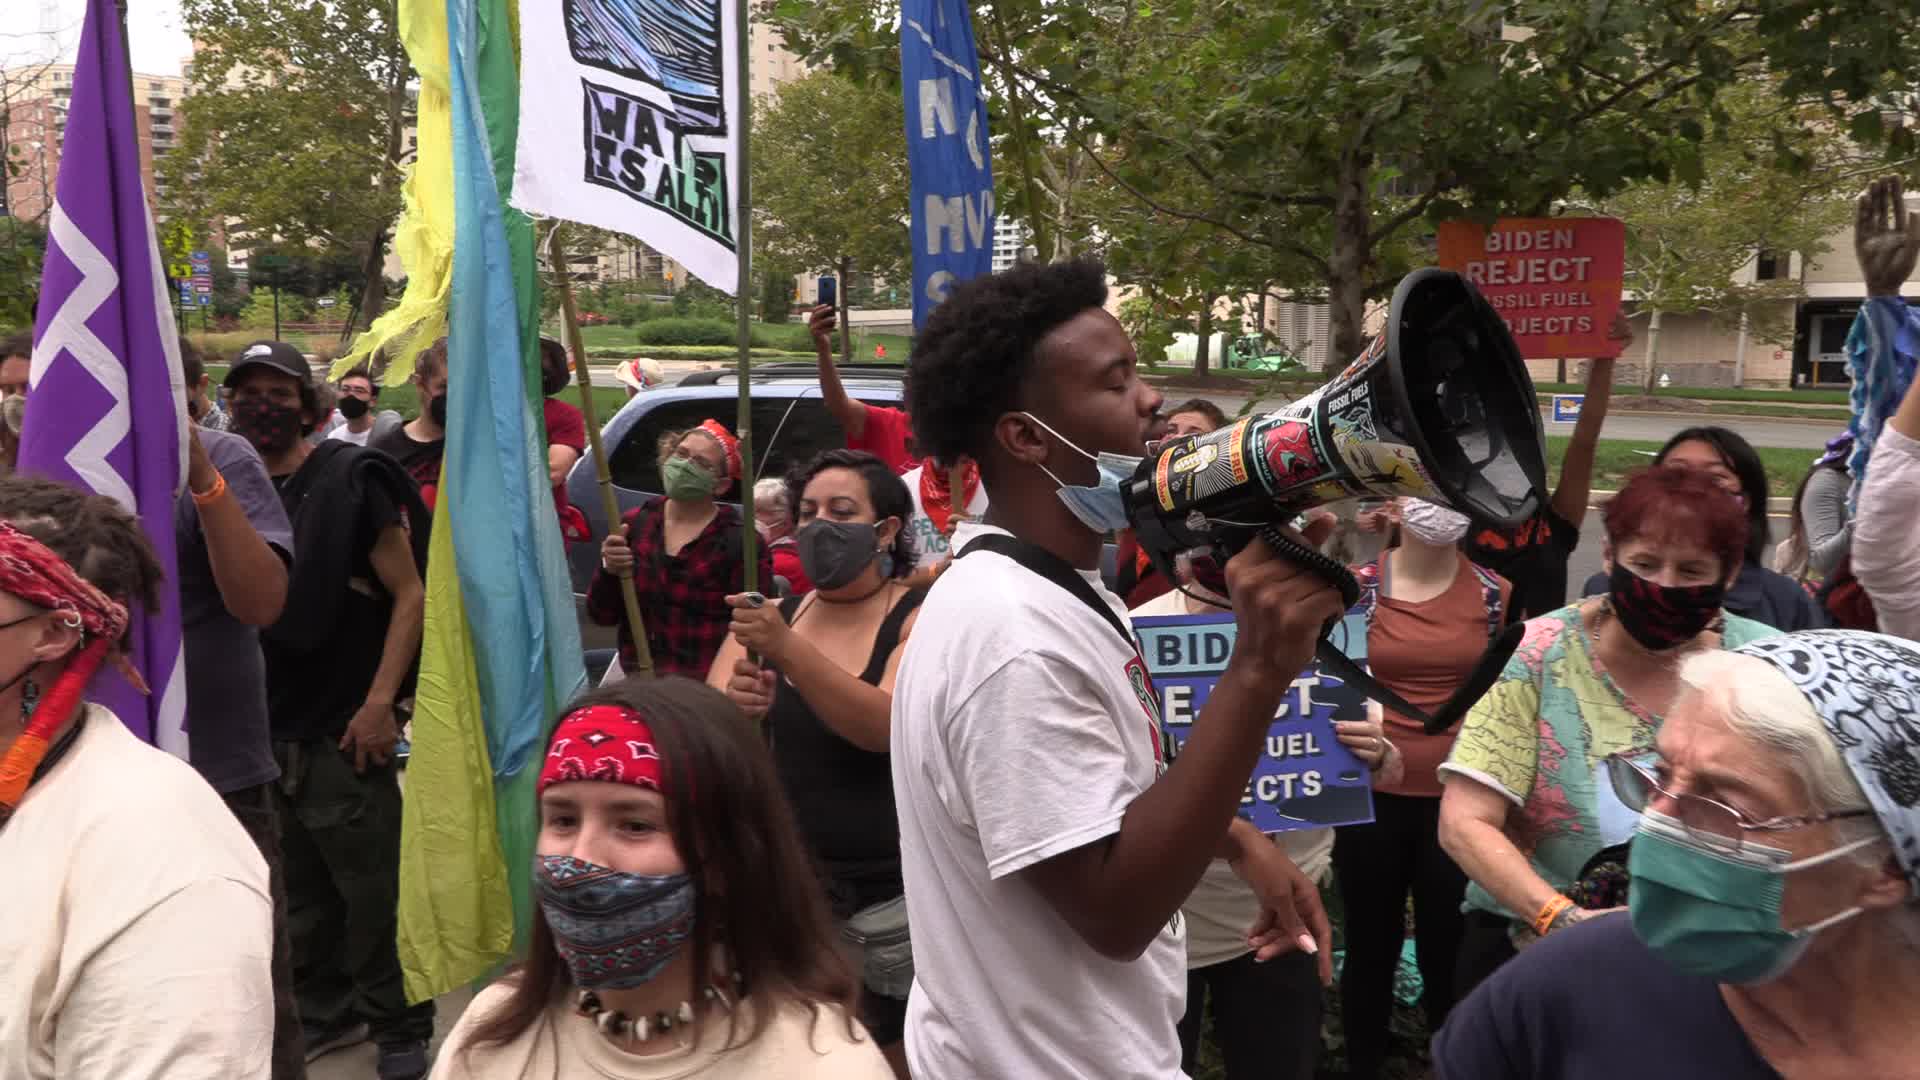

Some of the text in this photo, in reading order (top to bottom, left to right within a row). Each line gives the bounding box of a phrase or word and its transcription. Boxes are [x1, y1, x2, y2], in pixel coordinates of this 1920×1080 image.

[593, 136, 648, 193] IS
[1485, 229, 1574, 252] BIDEN
[1465, 257, 1592, 284] REJECT
[1486, 292, 1592, 308] SSIL FUEL
[1506, 316, 1592, 335] JECTS
[1328, 394, 1351, 414] FOSSIL
[1351, 380, 1369, 402] FUELS
[1231, 451, 1246, 484] FREE
[1157, 631, 1229, 666] BID
[1267, 733, 1321, 757] UEL
